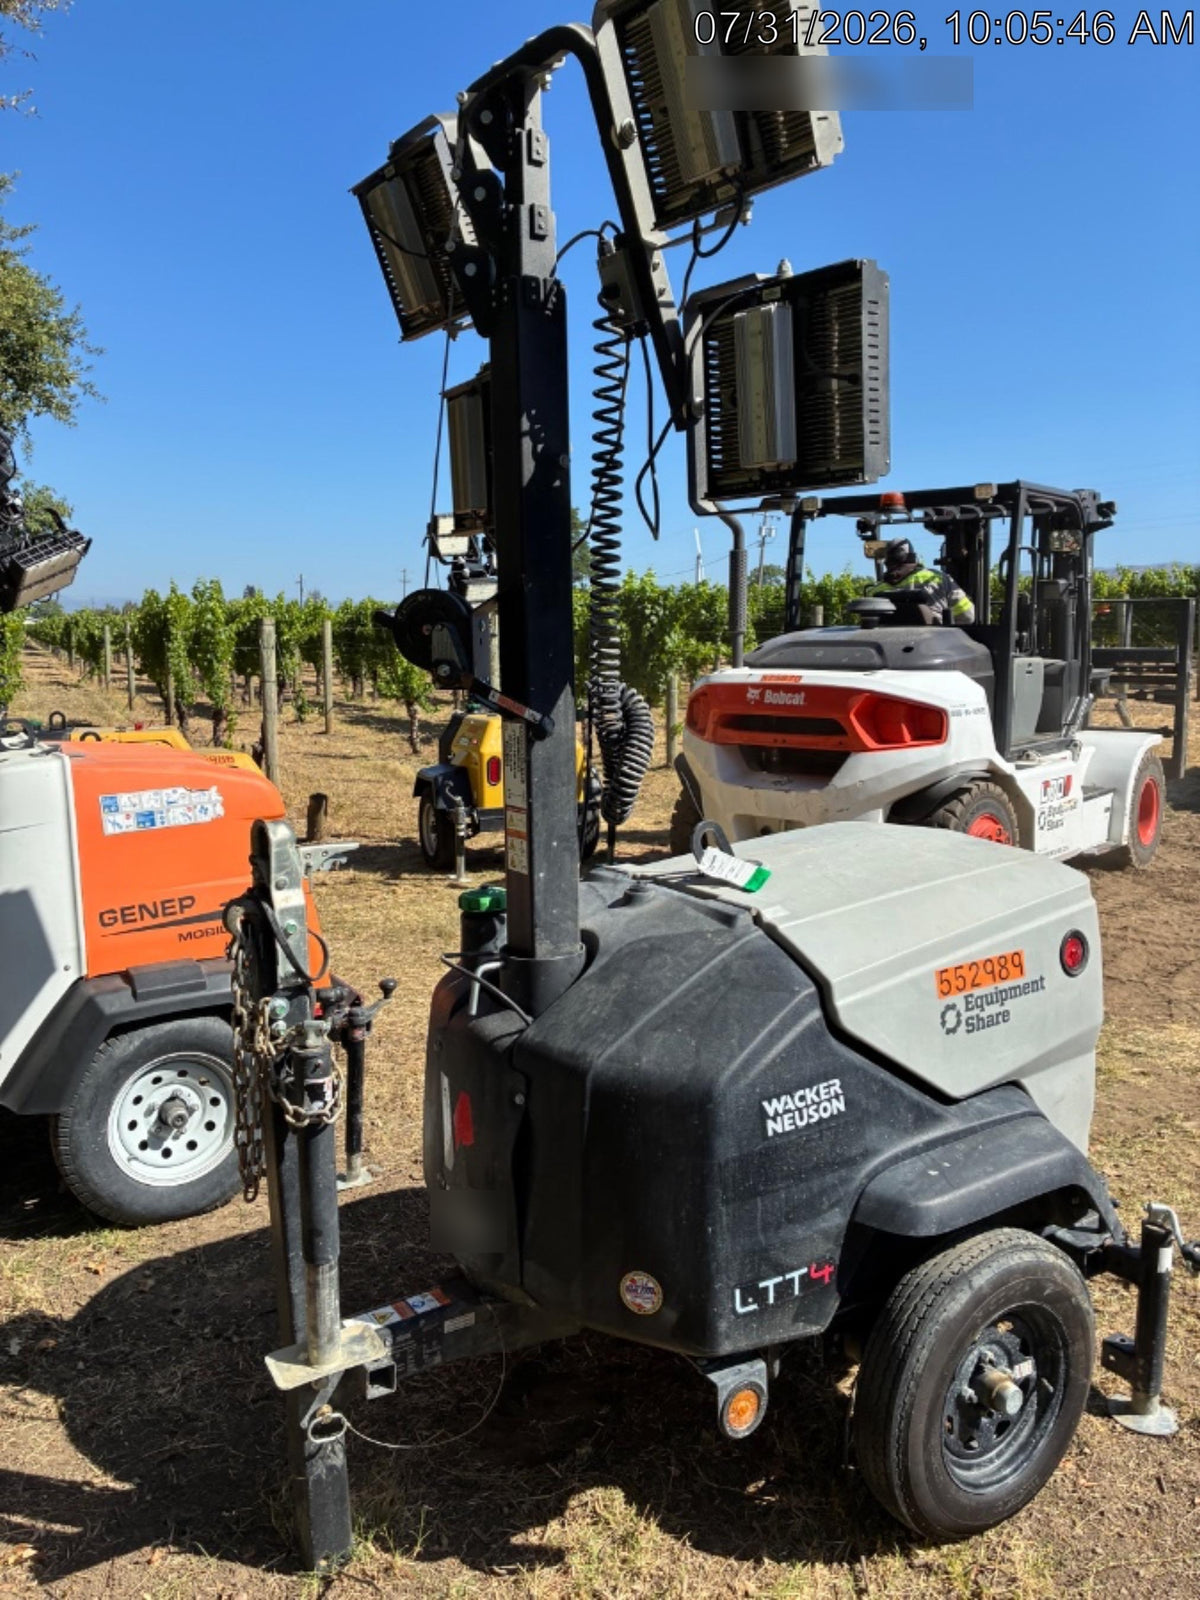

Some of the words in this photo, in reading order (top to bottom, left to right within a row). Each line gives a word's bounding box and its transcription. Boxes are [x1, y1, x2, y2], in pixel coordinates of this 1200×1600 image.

[764, 689, 805, 705] Bobcat
[938, 951, 1025, 997] 552989
[963, 974, 1046, 1012] Equipment
[964, 1008, 1011, 1034] Share
[762, 1078, 843, 1118] WACKER
[765, 1095, 846, 1137] NEUSON
[733, 1262, 835, 1314] LTT4
